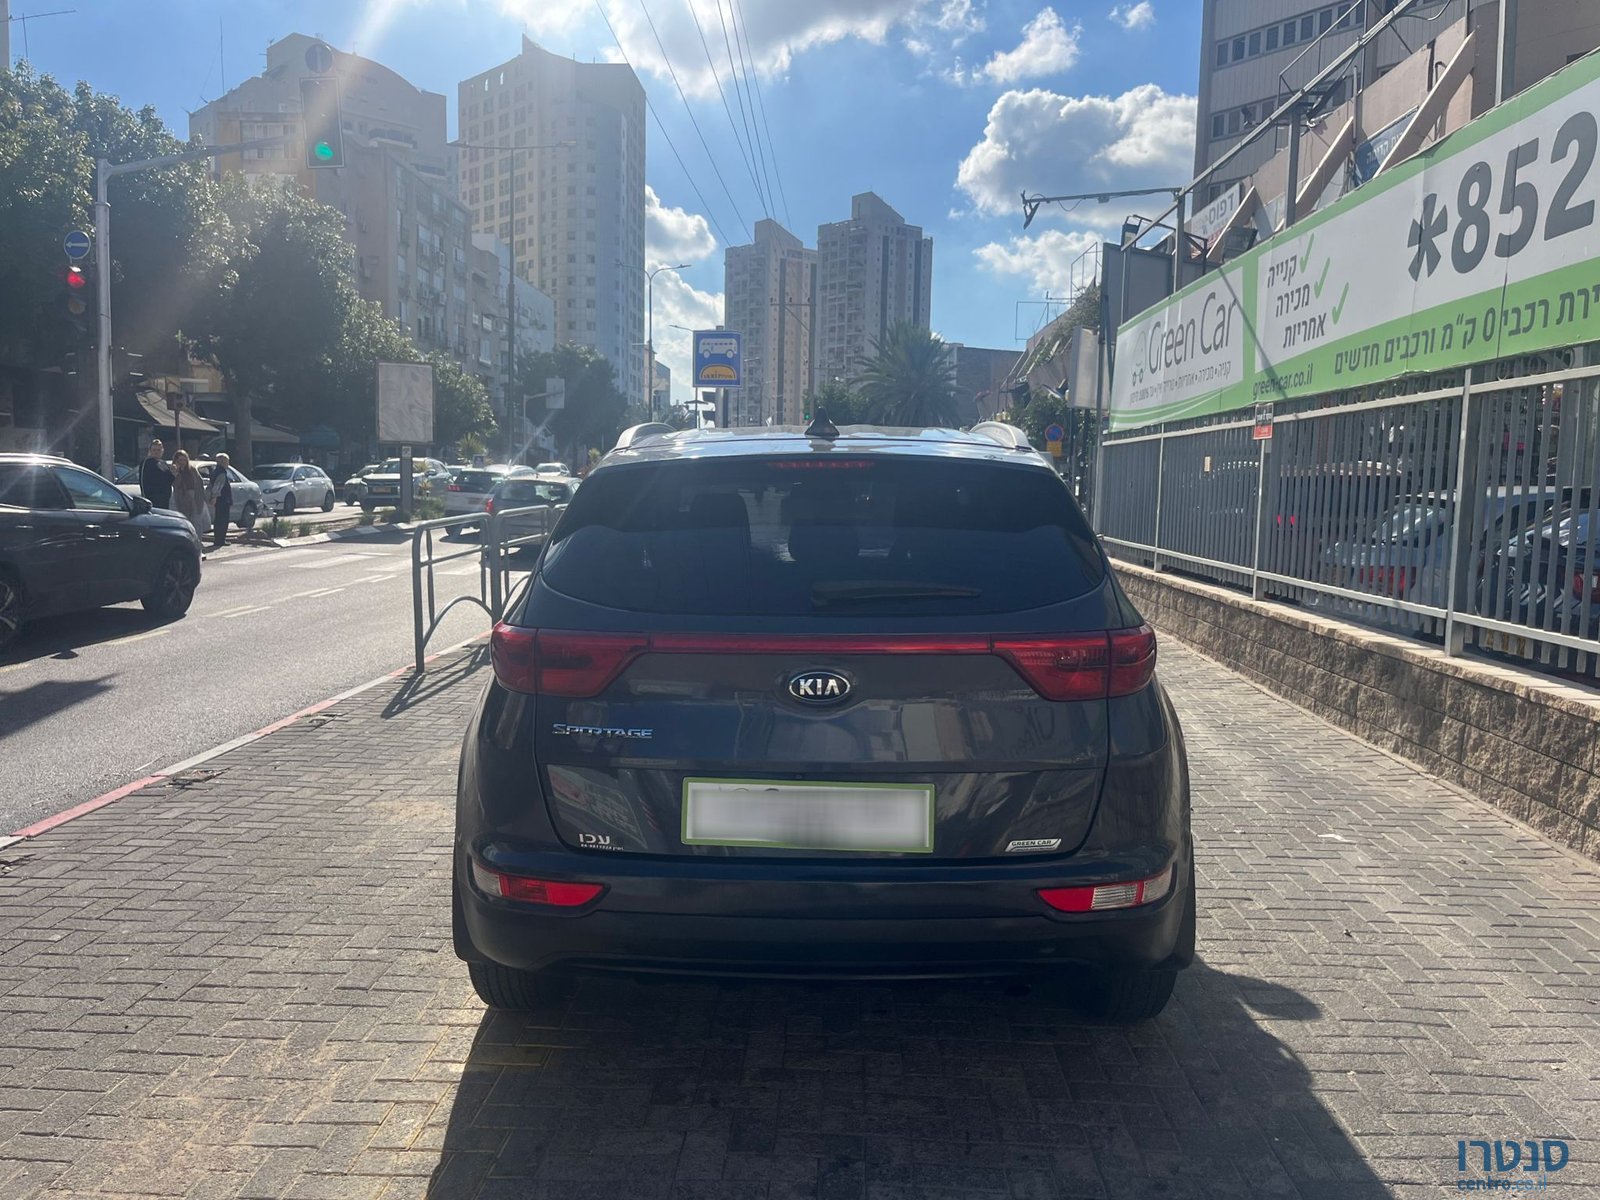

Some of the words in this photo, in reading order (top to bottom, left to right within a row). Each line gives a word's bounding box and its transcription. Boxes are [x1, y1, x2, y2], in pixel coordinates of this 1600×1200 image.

[1208, 193, 1235, 225] דפוס
[1267, 255, 1298, 289] קנייה
[1275, 284, 1311, 318] מכירה
[1501, 299, 1550, 336] רכבי
[1149, 318, 1196, 375] Green
[1201, 292, 1237, 355] Car
[1283, 312, 1327, 349] אחריות
[1384, 327, 1436, 364] ורכבים
[1334, 343, 1380, 375] חדשים
[1253, 363, 1314, 400] green-car.co.il
[799, 679, 840, 695] KIA
[552, 723, 653, 739] SPORTAGE
